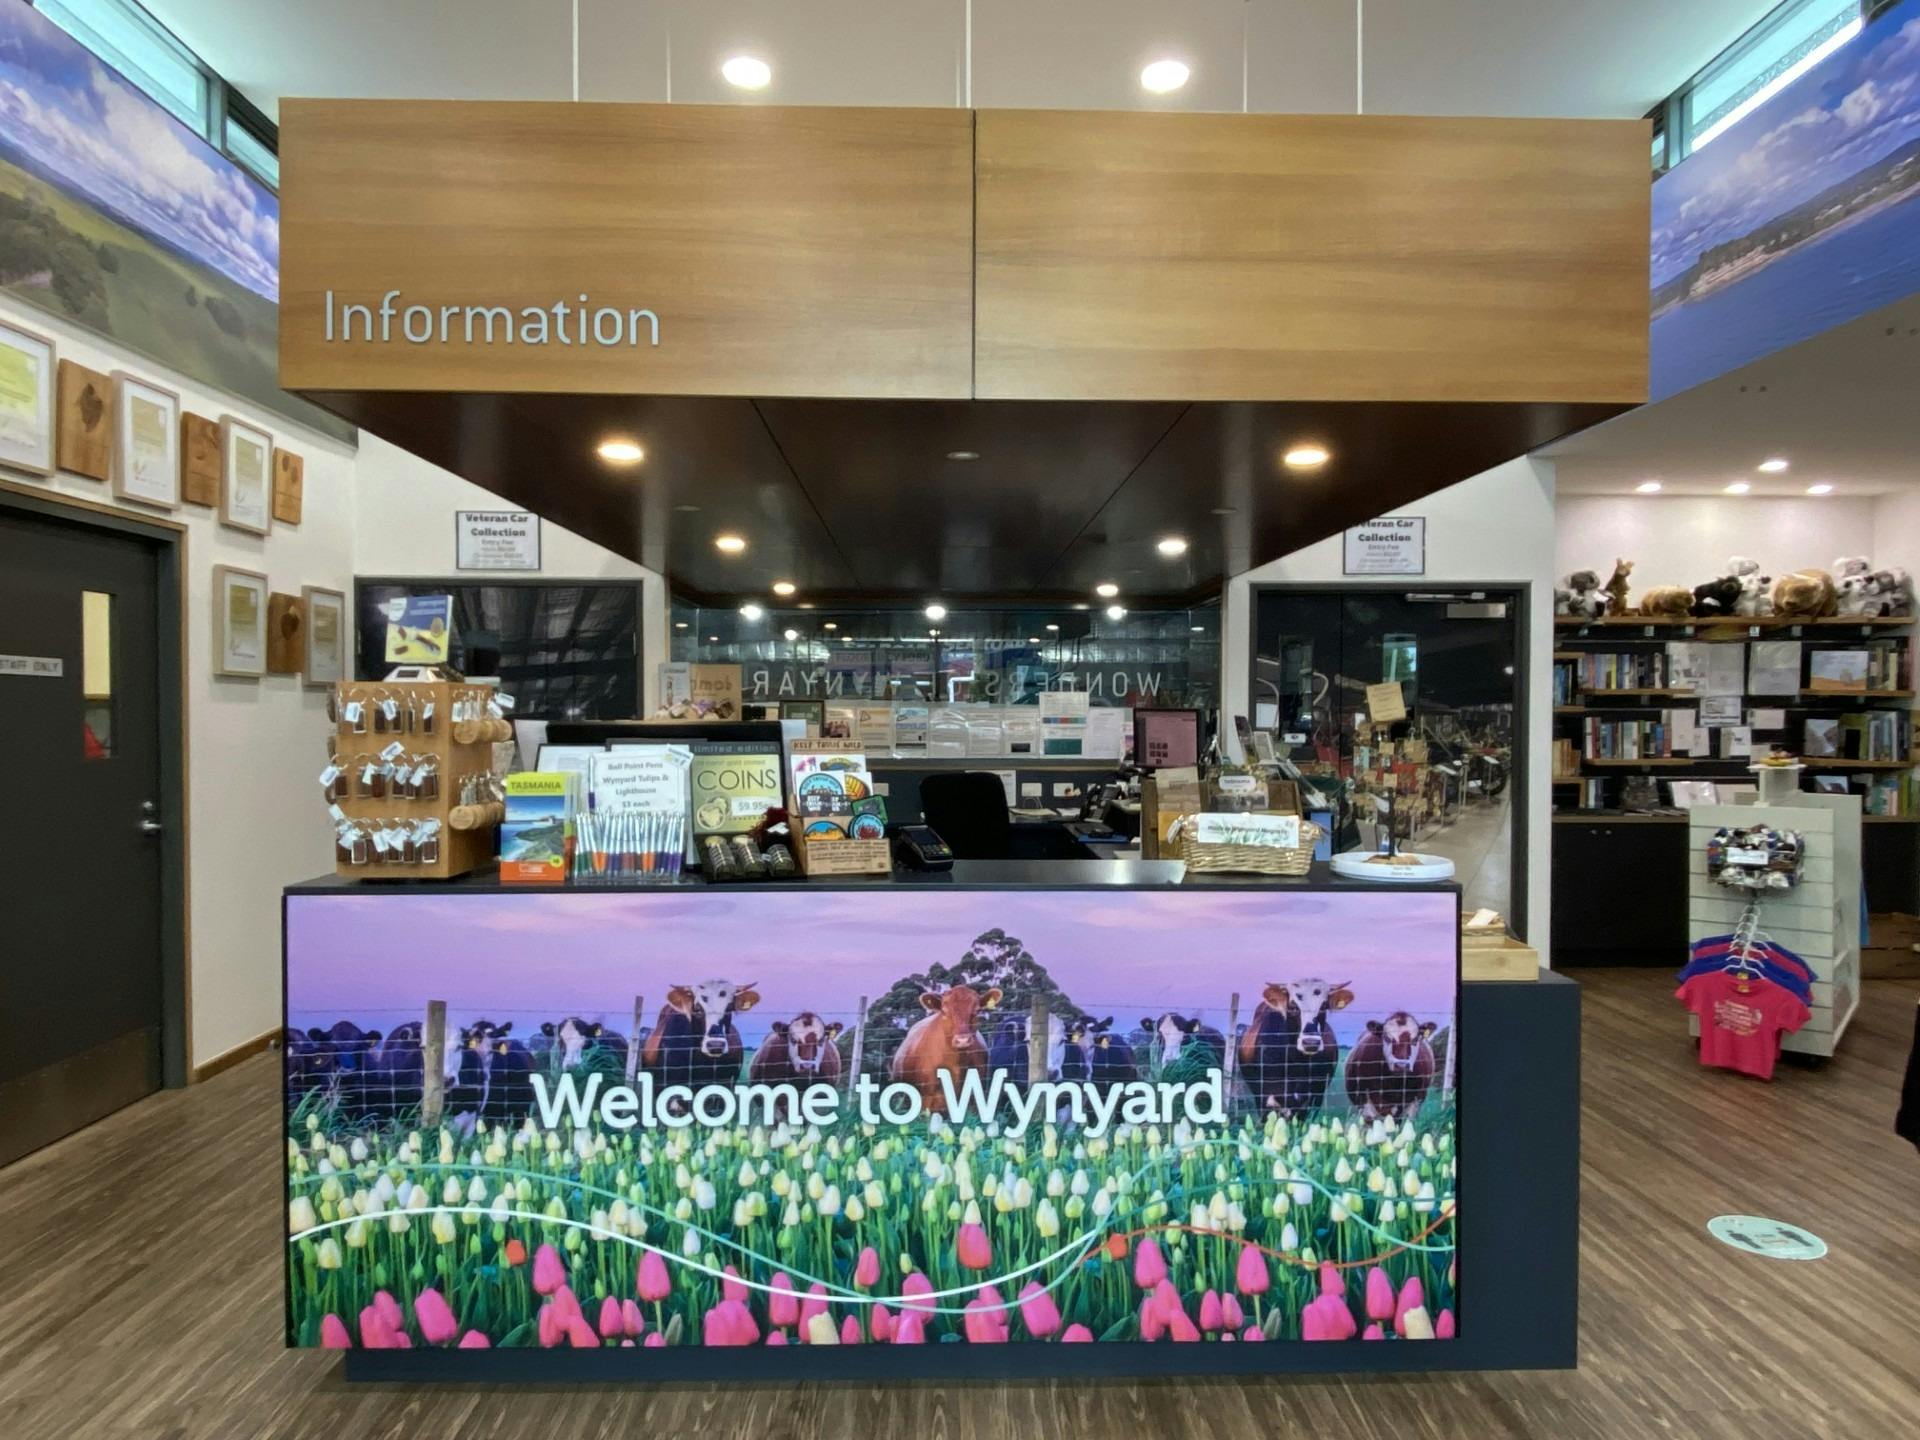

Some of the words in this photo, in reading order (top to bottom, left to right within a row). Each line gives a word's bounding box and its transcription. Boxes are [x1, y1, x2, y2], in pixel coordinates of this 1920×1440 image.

[325, 290, 660, 345] Information
[466, 514, 508, 522] Veteran
[510, 514, 529, 522] Car
[1396, 520, 1414, 528] Car
[471, 528, 526, 536] Collection
[1358, 533, 1411, 541] Collection
[694, 745, 732, 753] limited
[737, 744, 777, 753] edition
[603, 776, 637, 785] Wynyard
[638, 775, 661, 784] Tulips
[662, 774, 669, 782] &
[697, 768, 777, 791] COINS
[511, 782, 562, 790] TASMANIA
[615, 788, 657, 797] Lighthouse
[633, 800, 650, 808] each
[529, 1072, 839, 1129] Welcome
[855, 1073, 922, 1125] to
[937, 1067, 1226, 1139] Wynyard
